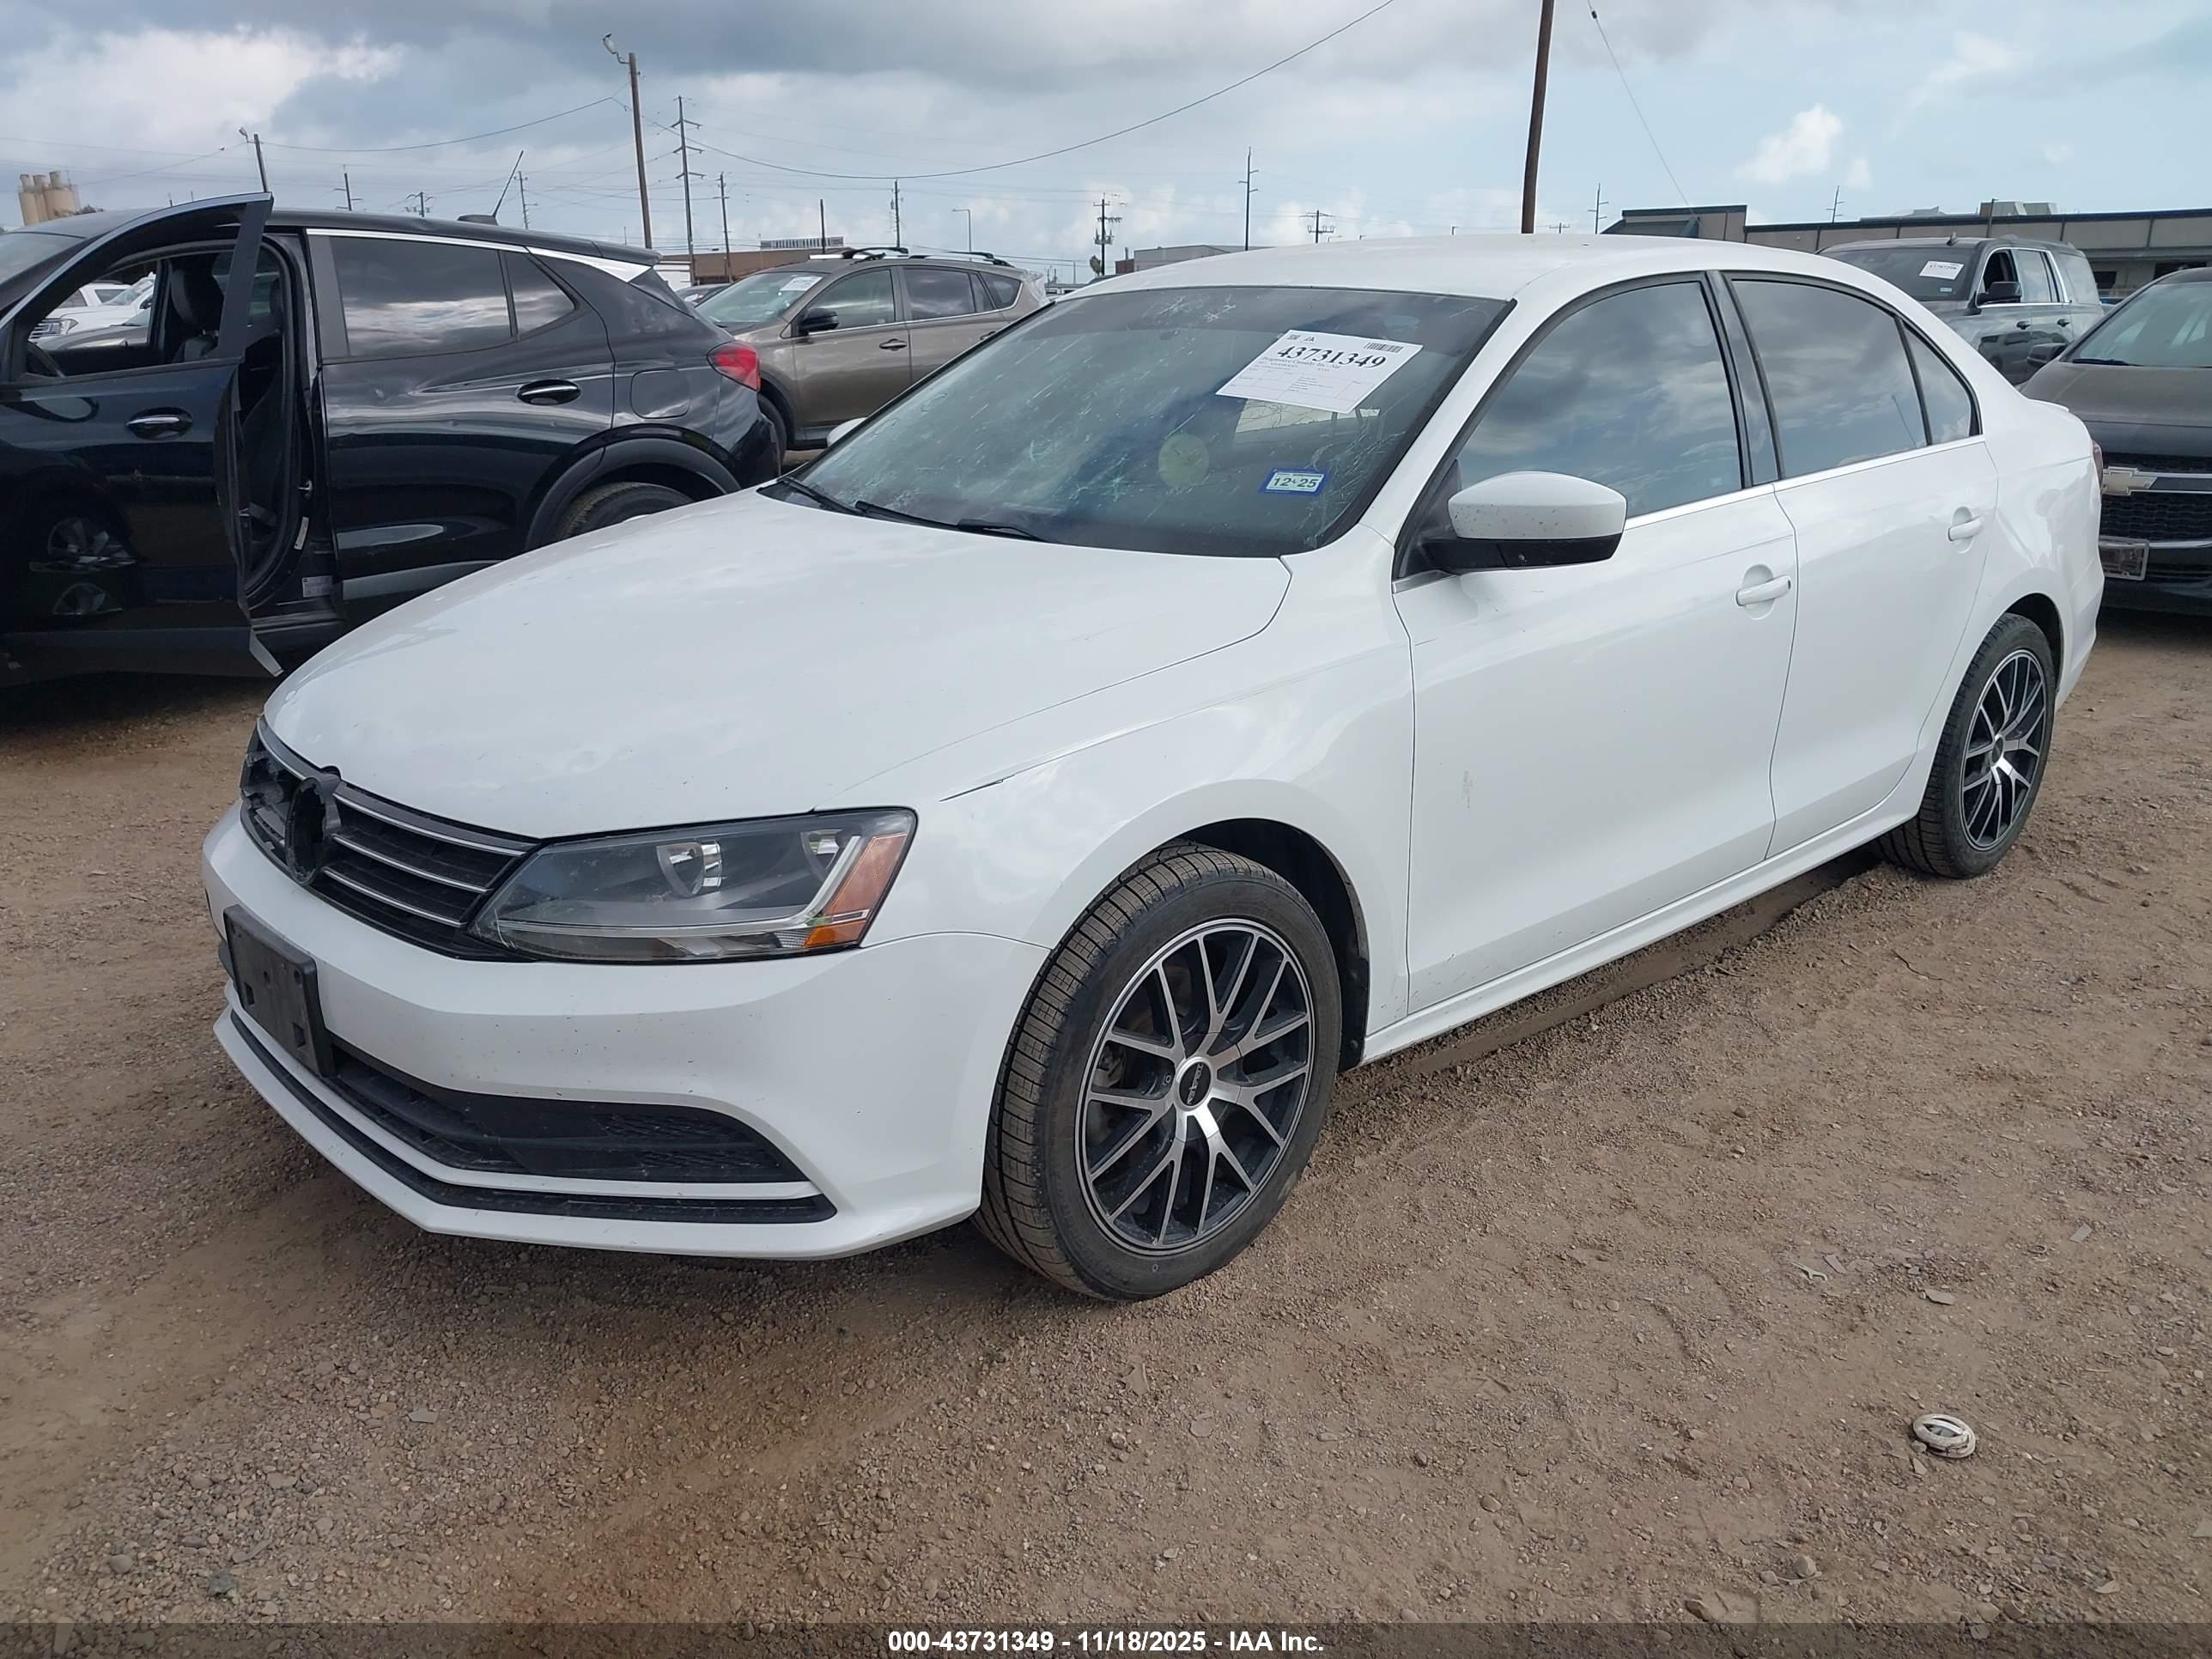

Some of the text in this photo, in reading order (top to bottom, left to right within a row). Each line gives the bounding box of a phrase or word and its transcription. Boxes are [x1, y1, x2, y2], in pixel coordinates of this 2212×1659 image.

[1278, 346, 1386, 368] 43731349
[1273, 477, 1319, 488] 12 25
